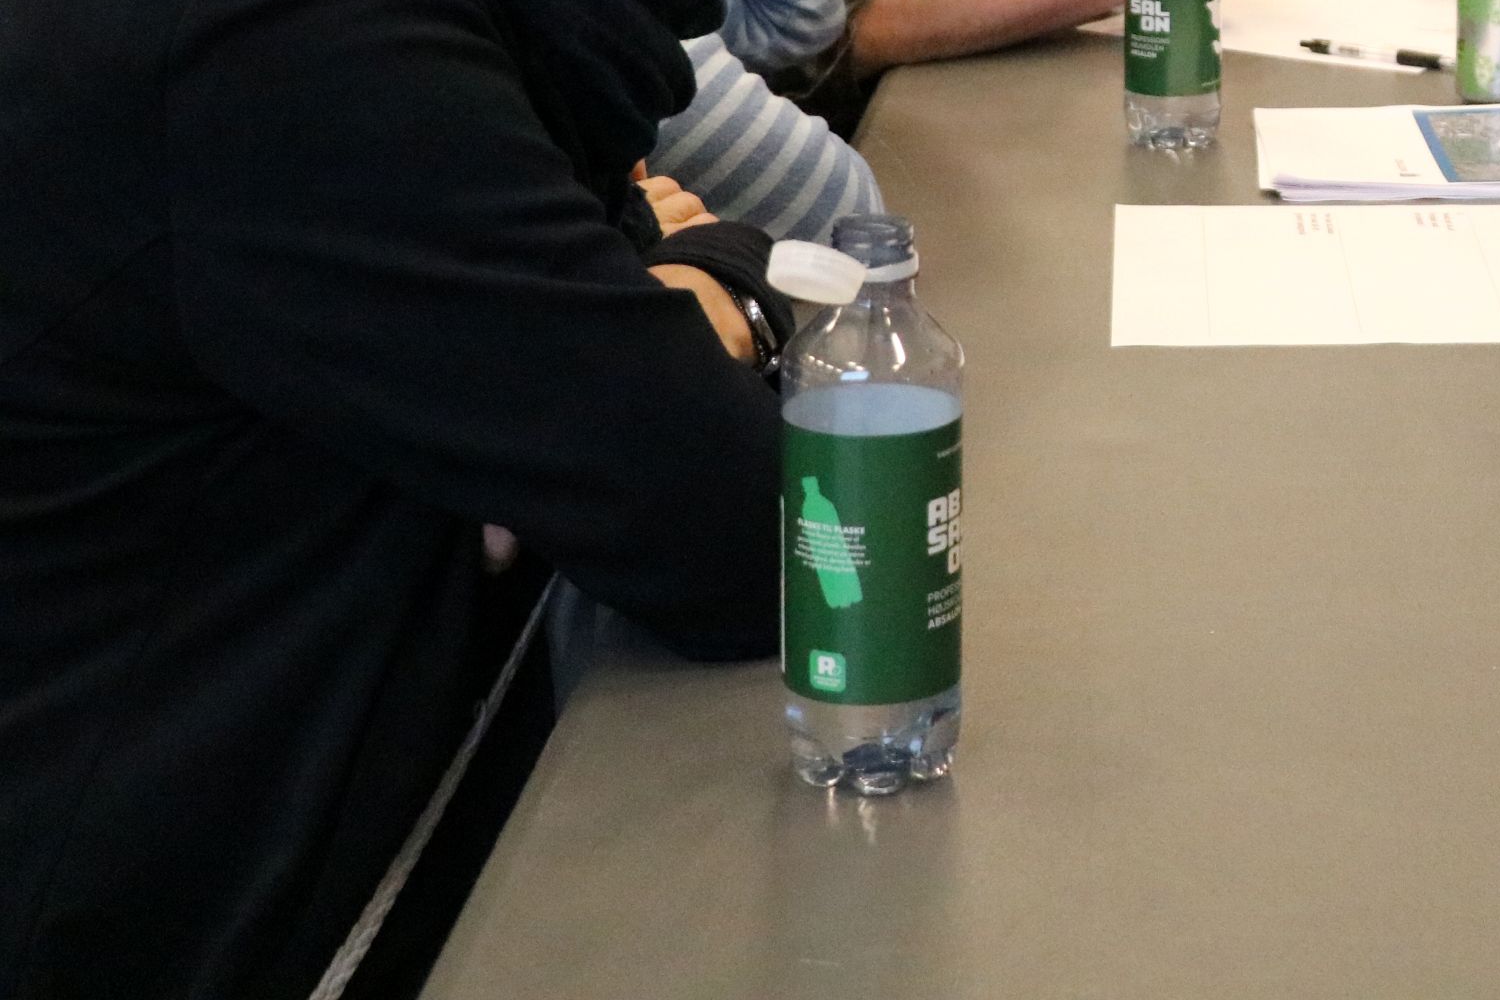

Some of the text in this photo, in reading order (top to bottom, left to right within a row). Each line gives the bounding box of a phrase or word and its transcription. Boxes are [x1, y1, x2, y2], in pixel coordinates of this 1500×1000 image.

[1140, 14, 1170, 32] ON
[928, 488, 961, 527] AB
[928, 517, 961, 556] SA
